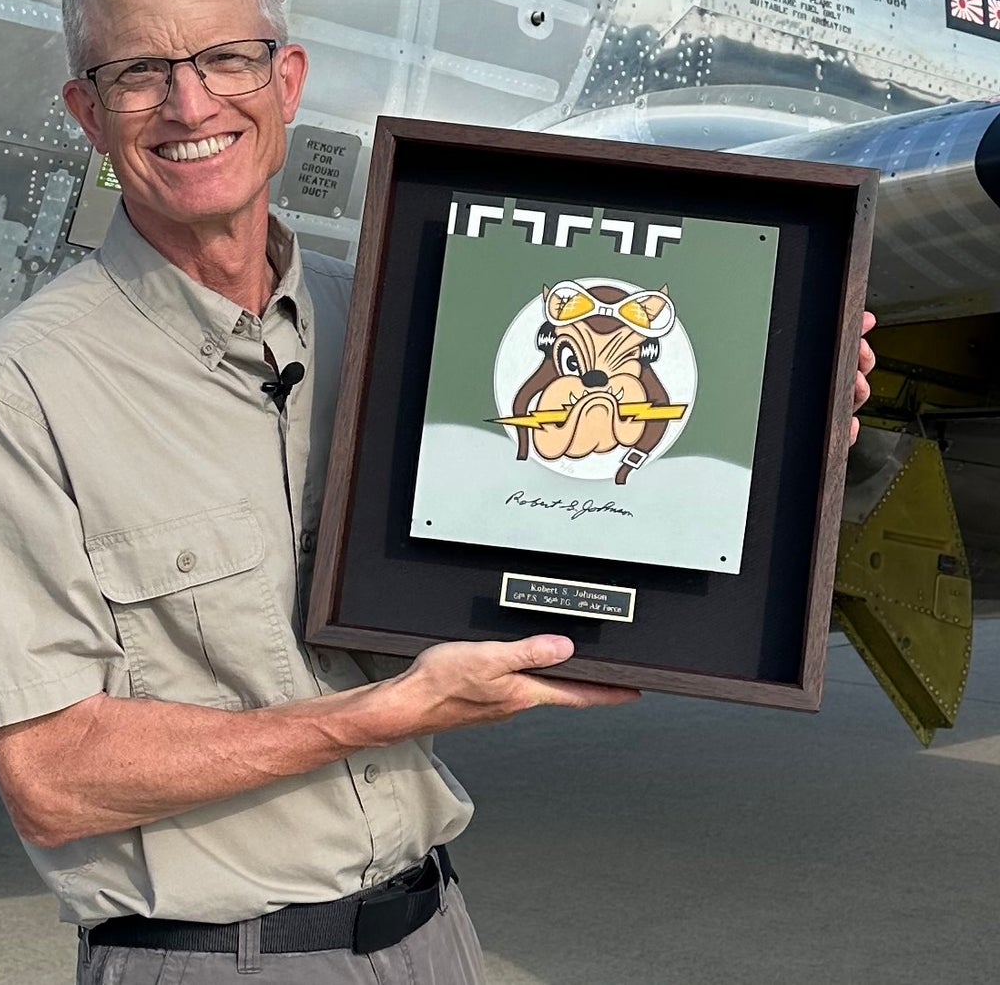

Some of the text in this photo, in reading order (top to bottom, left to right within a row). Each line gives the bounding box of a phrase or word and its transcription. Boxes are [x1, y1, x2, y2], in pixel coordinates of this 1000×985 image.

[307, 140, 346, 157] REMOVE
[313, 154, 333, 165] FOR
[301, 162, 340, 178] GROUND
[298, 174, 337, 190] HEATER
[302, 186, 328, 199] DUCT
[530, 583, 558, 595] Robert
[573, 589, 607, 601] Johnson
